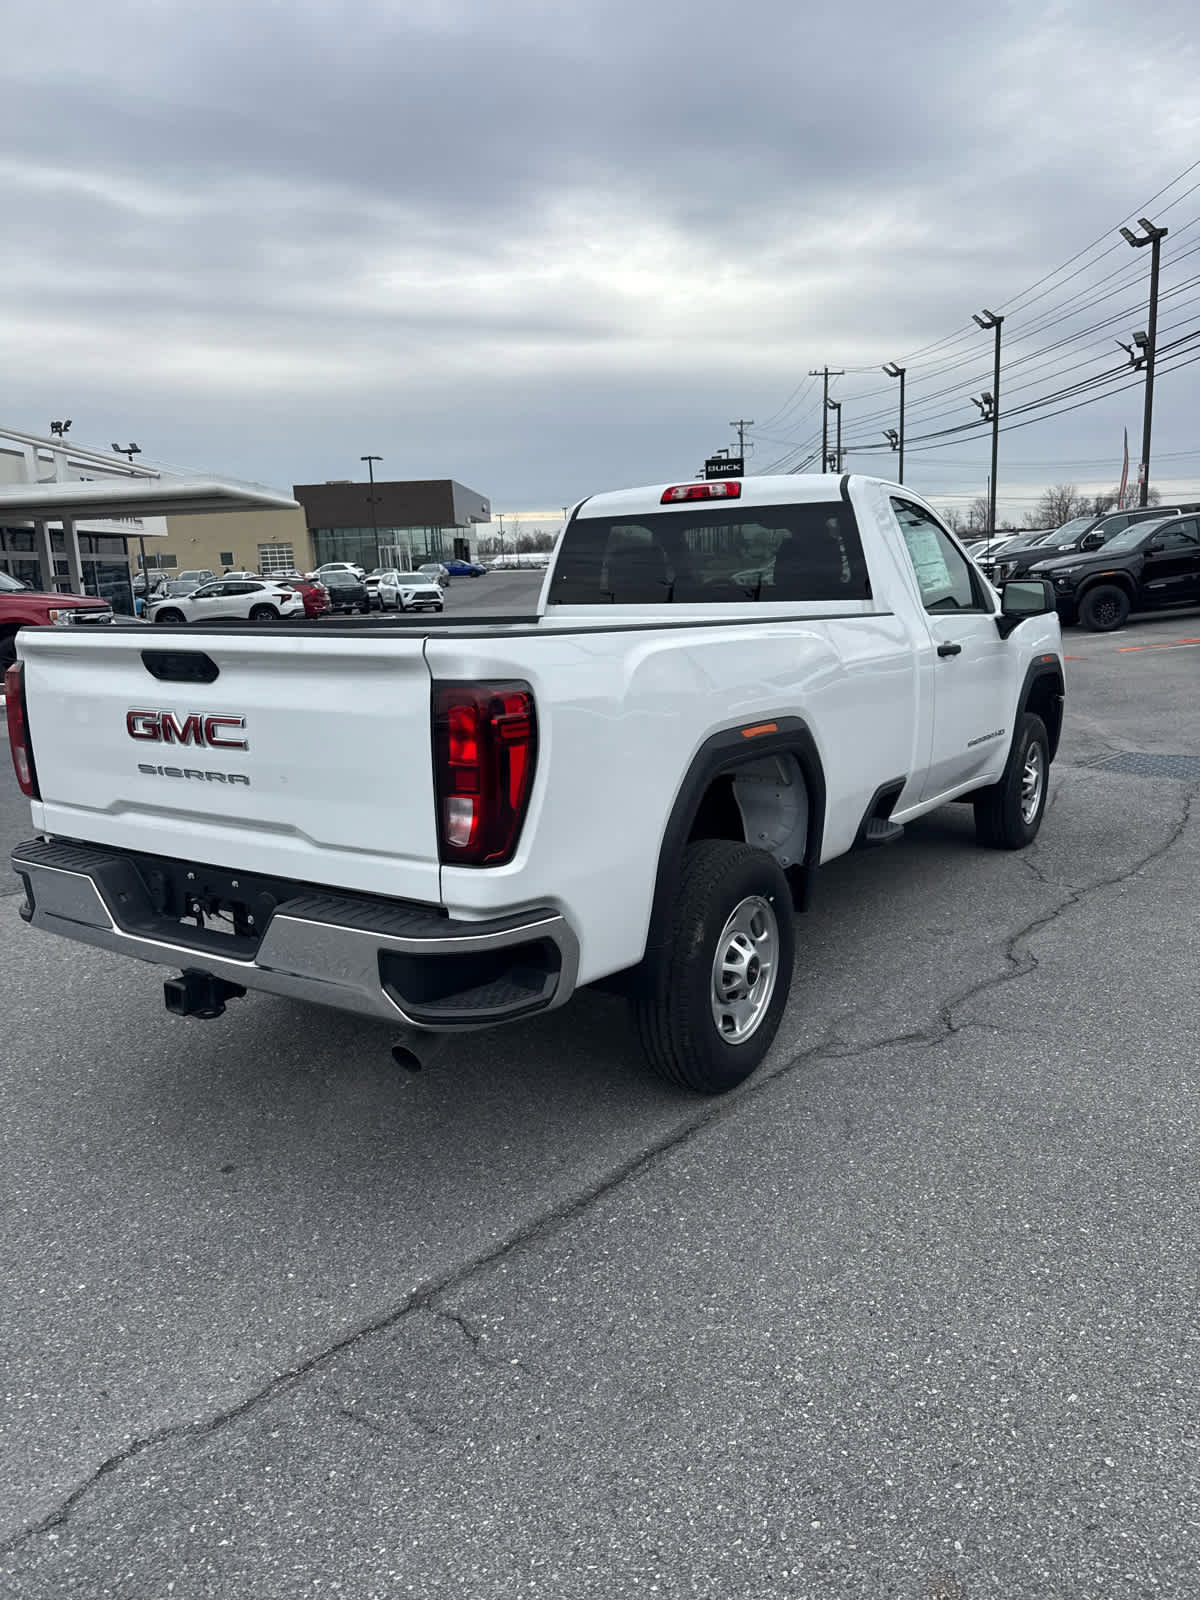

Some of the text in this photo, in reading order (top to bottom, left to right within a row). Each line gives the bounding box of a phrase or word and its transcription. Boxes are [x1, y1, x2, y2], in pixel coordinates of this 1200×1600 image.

[707, 464, 741, 472] BUICK
[126, 707, 249, 751] GMC
[137, 763, 250, 786] SIERRA
